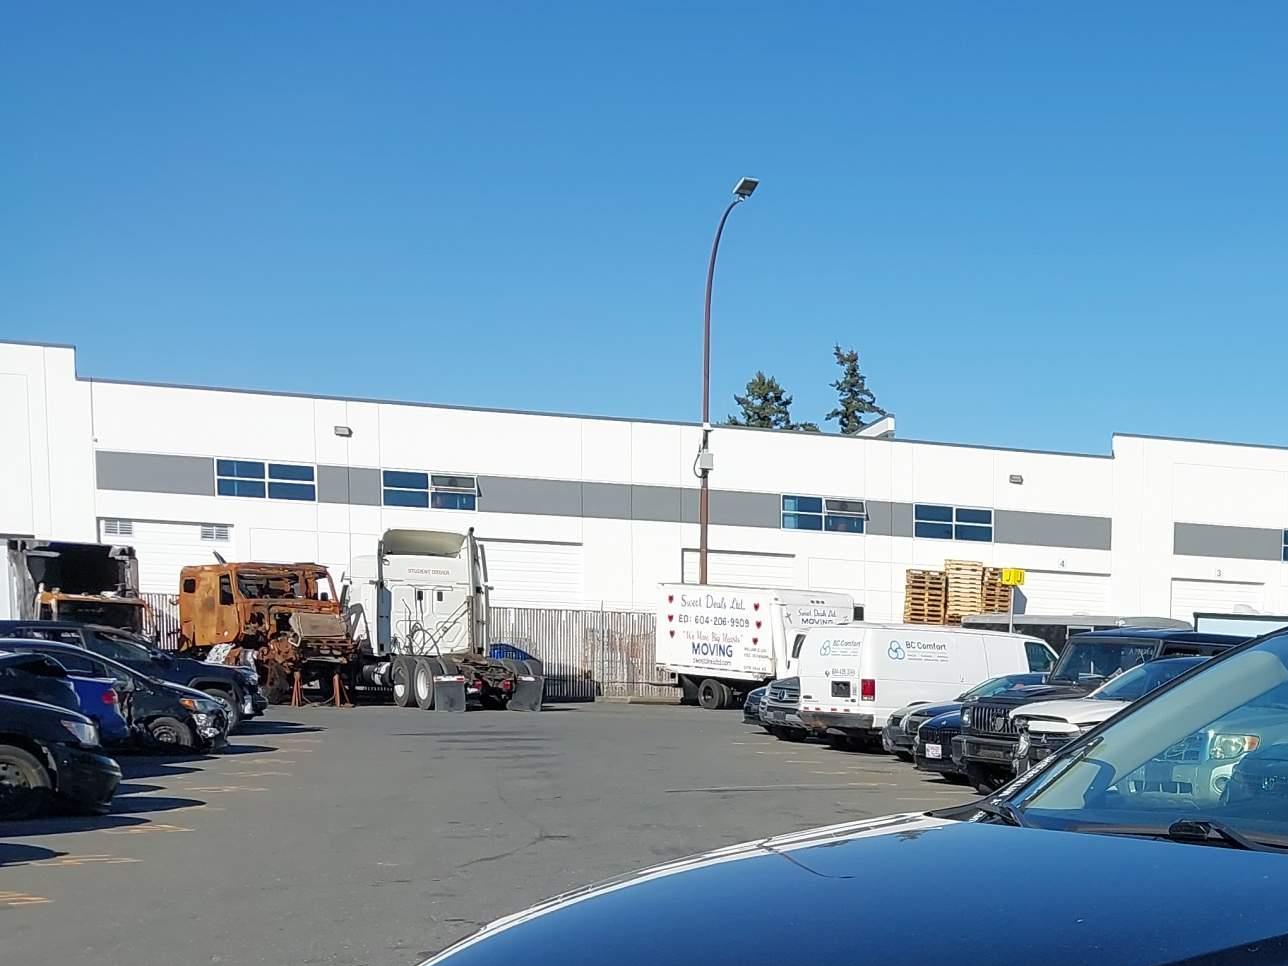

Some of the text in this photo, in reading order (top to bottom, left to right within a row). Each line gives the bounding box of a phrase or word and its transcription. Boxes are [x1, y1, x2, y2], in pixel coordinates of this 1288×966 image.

[1059, 559, 1066, 568] 4
[1216, 569, 1223, 578] 3
[691, 641, 734, 658] MOVING
[905, 640, 948, 651] BC Comfort
